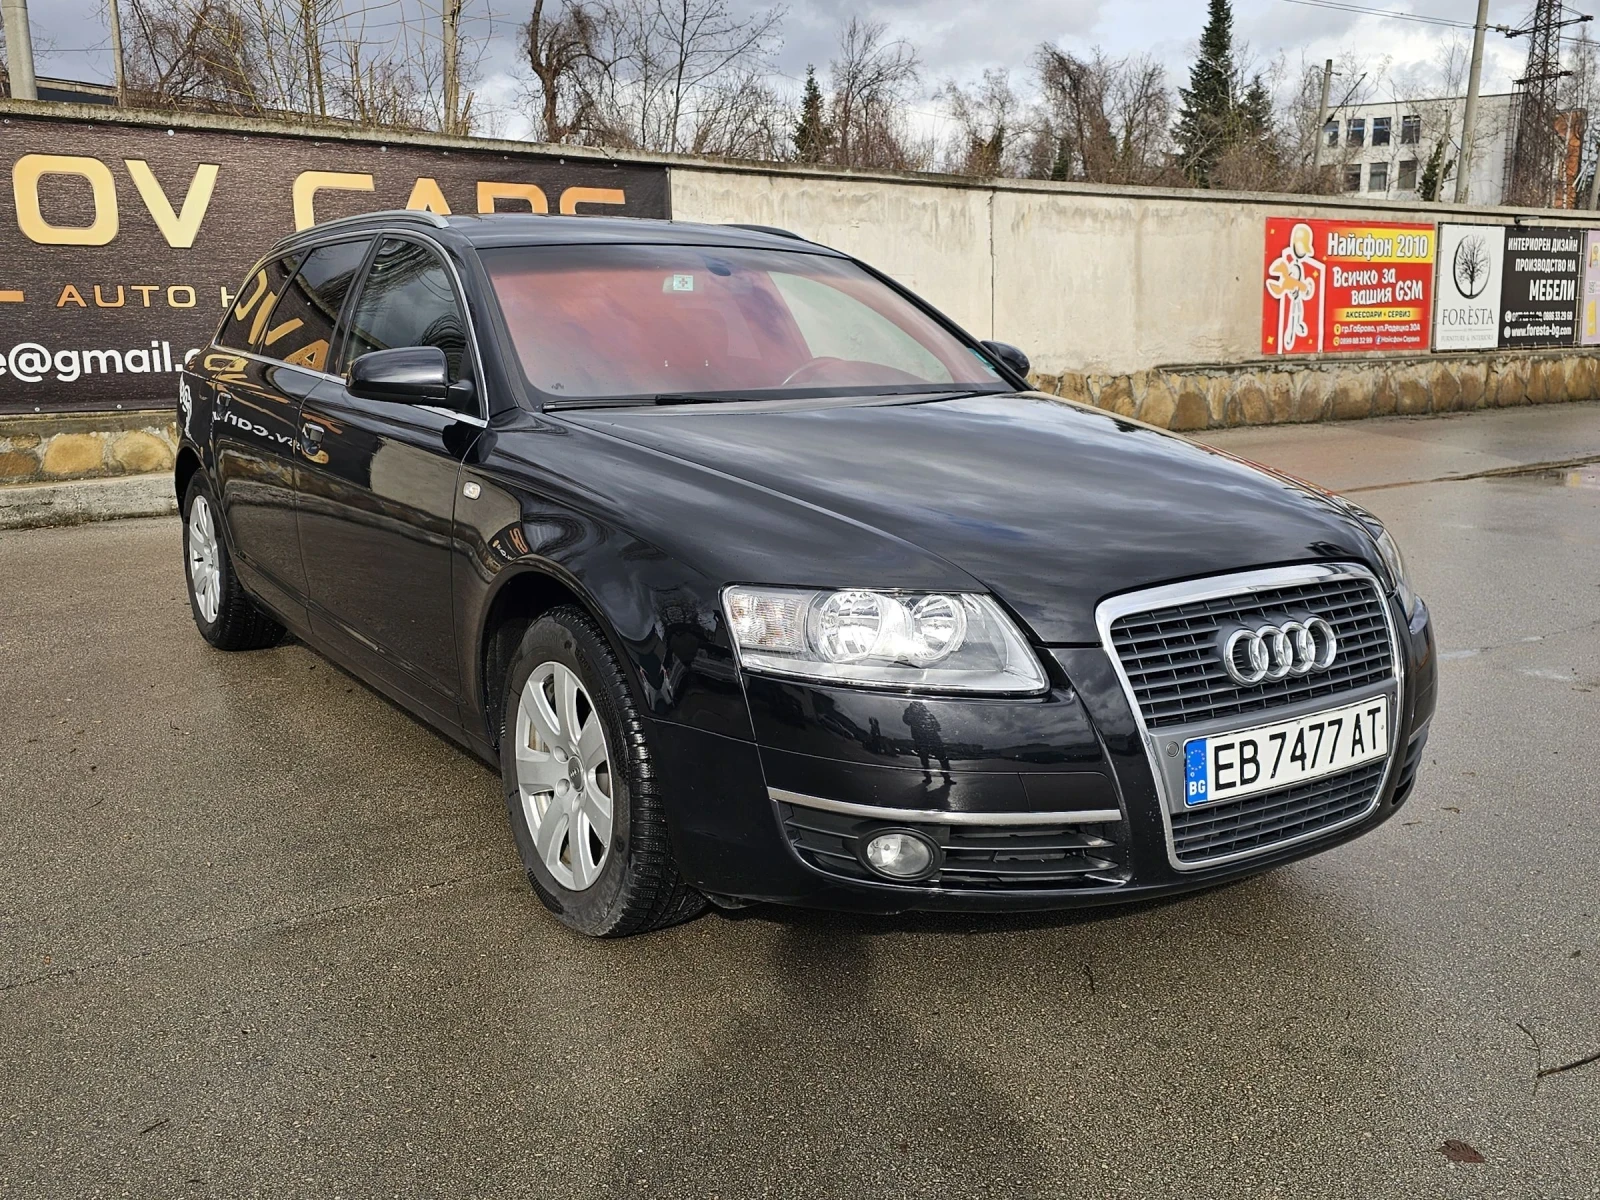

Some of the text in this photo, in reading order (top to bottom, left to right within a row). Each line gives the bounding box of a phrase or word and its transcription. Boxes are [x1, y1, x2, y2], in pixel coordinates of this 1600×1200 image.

[1327, 232, 1429, 261] Найсфон 2010
[1508, 236, 1578, 253] ИНТЕРИОРЕН ДИЗАЙН
[1515, 258, 1576, 273] ПРОИЗВОДСТВО НА
[1332, 266, 1396, 287] Всичко за
[56, 284, 196, 308] AUTO
[1351, 280, 1423, 306] вашия GSM
[1529, 279, 1575, 301] МЕБЕЛИ
[1345, 309, 1411, 319] АКСЕСОАРИ СЕРВИЗ
[1442, 306, 1495, 326] FORÈSTA
[1511, 323, 1572, 338] www.foresta-bg.com
[1214, 706, 1381, 792] EB 7477 AT
[1189, 779, 1206, 795] BG
